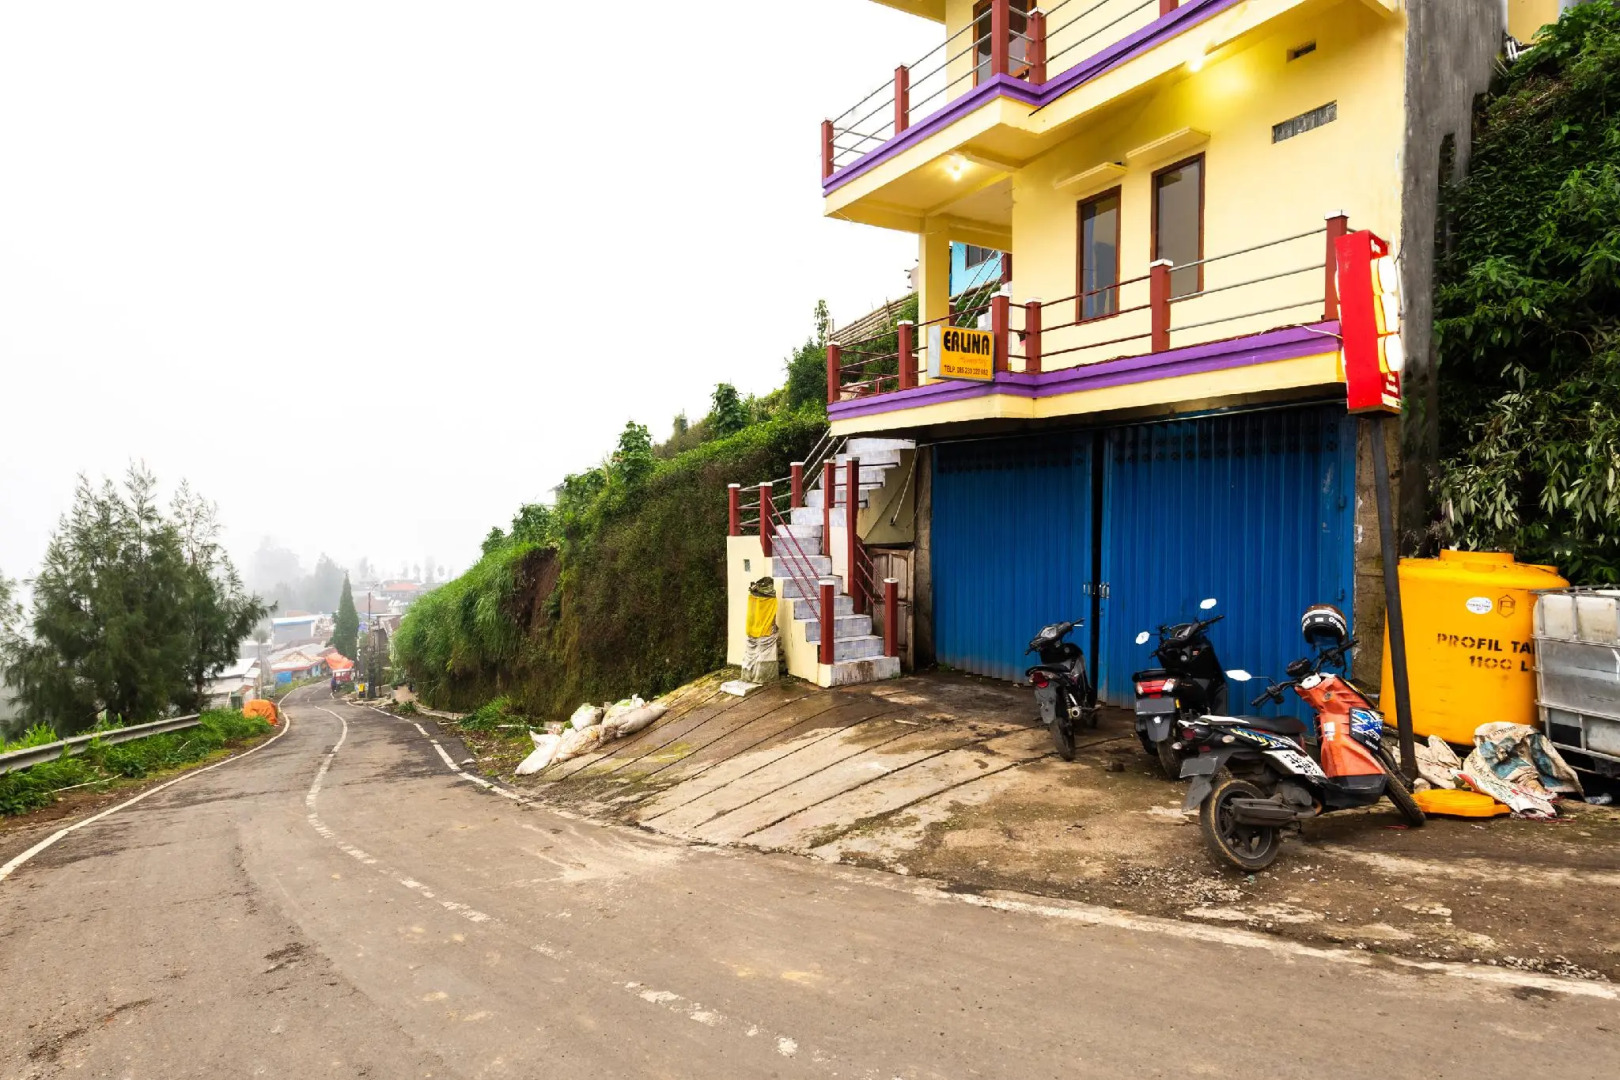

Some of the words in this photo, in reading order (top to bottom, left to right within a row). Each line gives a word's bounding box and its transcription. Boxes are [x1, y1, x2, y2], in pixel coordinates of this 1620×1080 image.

[1437, 633, 1503, 652] PROFIL
[1469, 655, 1512, 670] 1100
[1520, 660, 1529, 672] L
